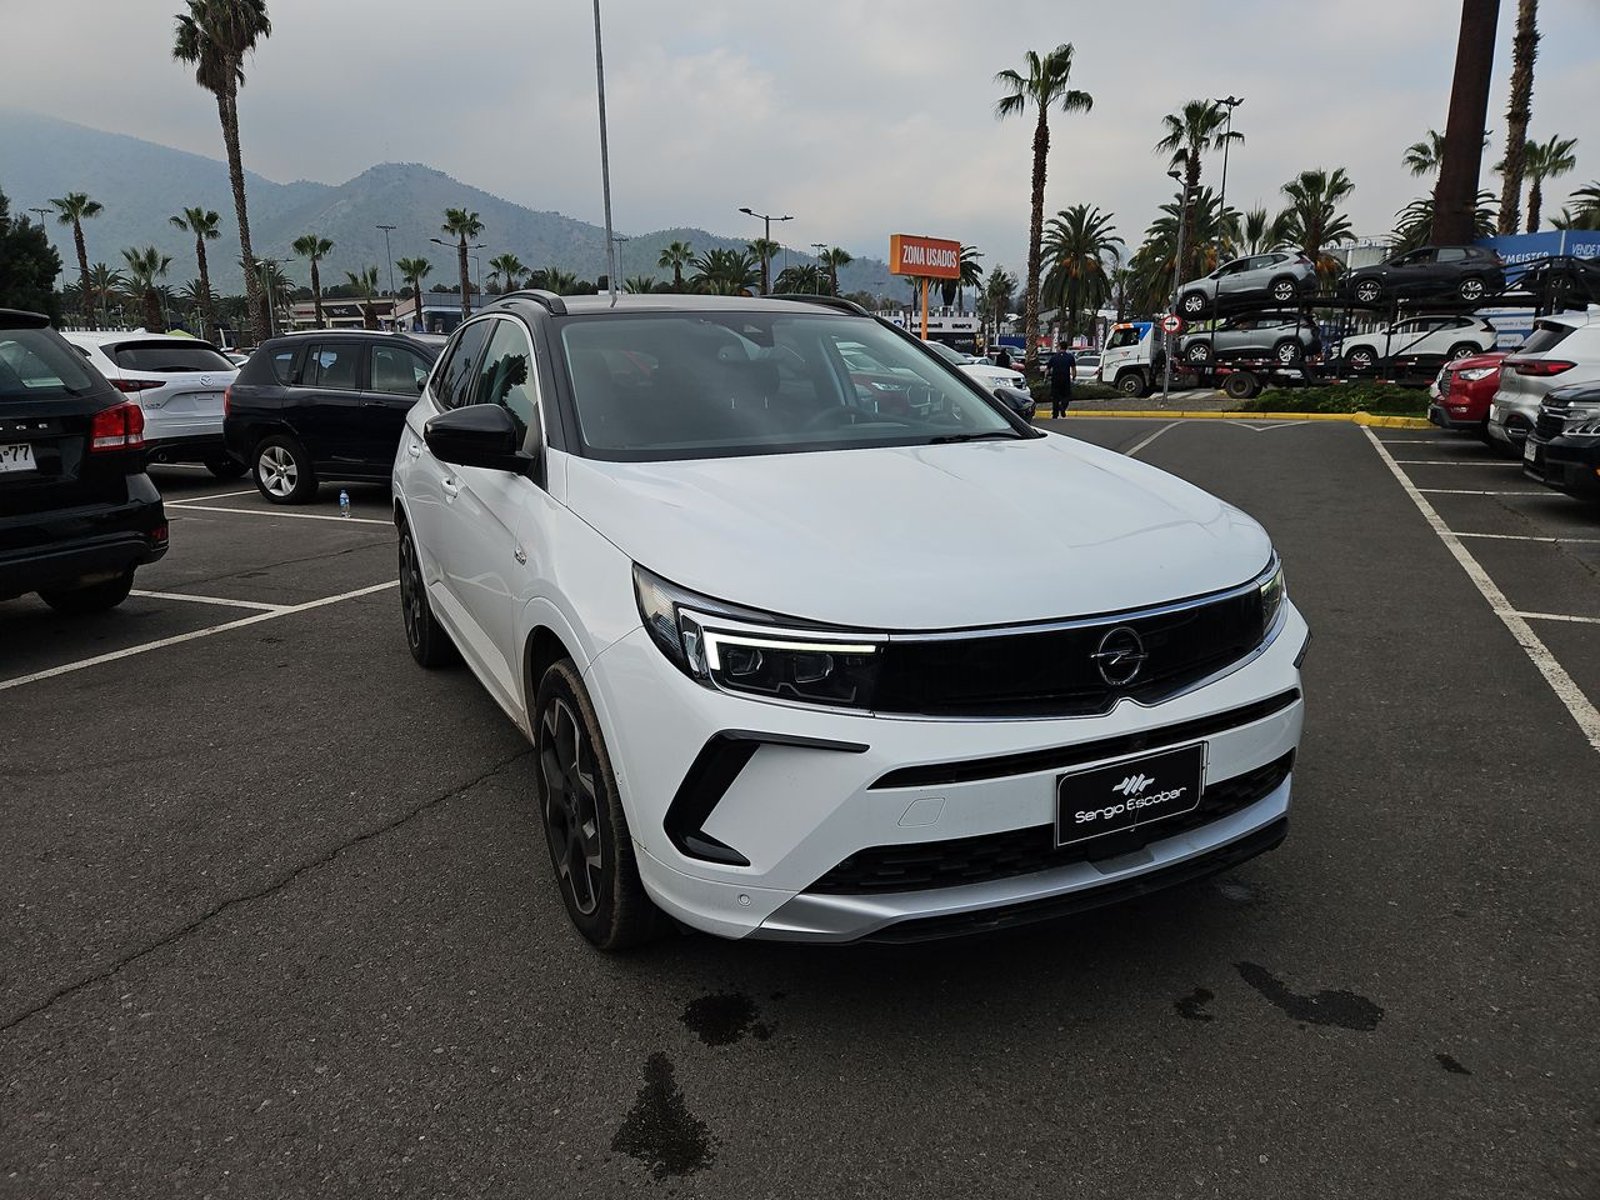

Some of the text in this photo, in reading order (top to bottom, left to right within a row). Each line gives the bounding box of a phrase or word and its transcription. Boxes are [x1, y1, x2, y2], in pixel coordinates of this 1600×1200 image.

[903, 245, 957, 268] ZONA USADOS
[1126, 787, 1187, 811] Escobar
